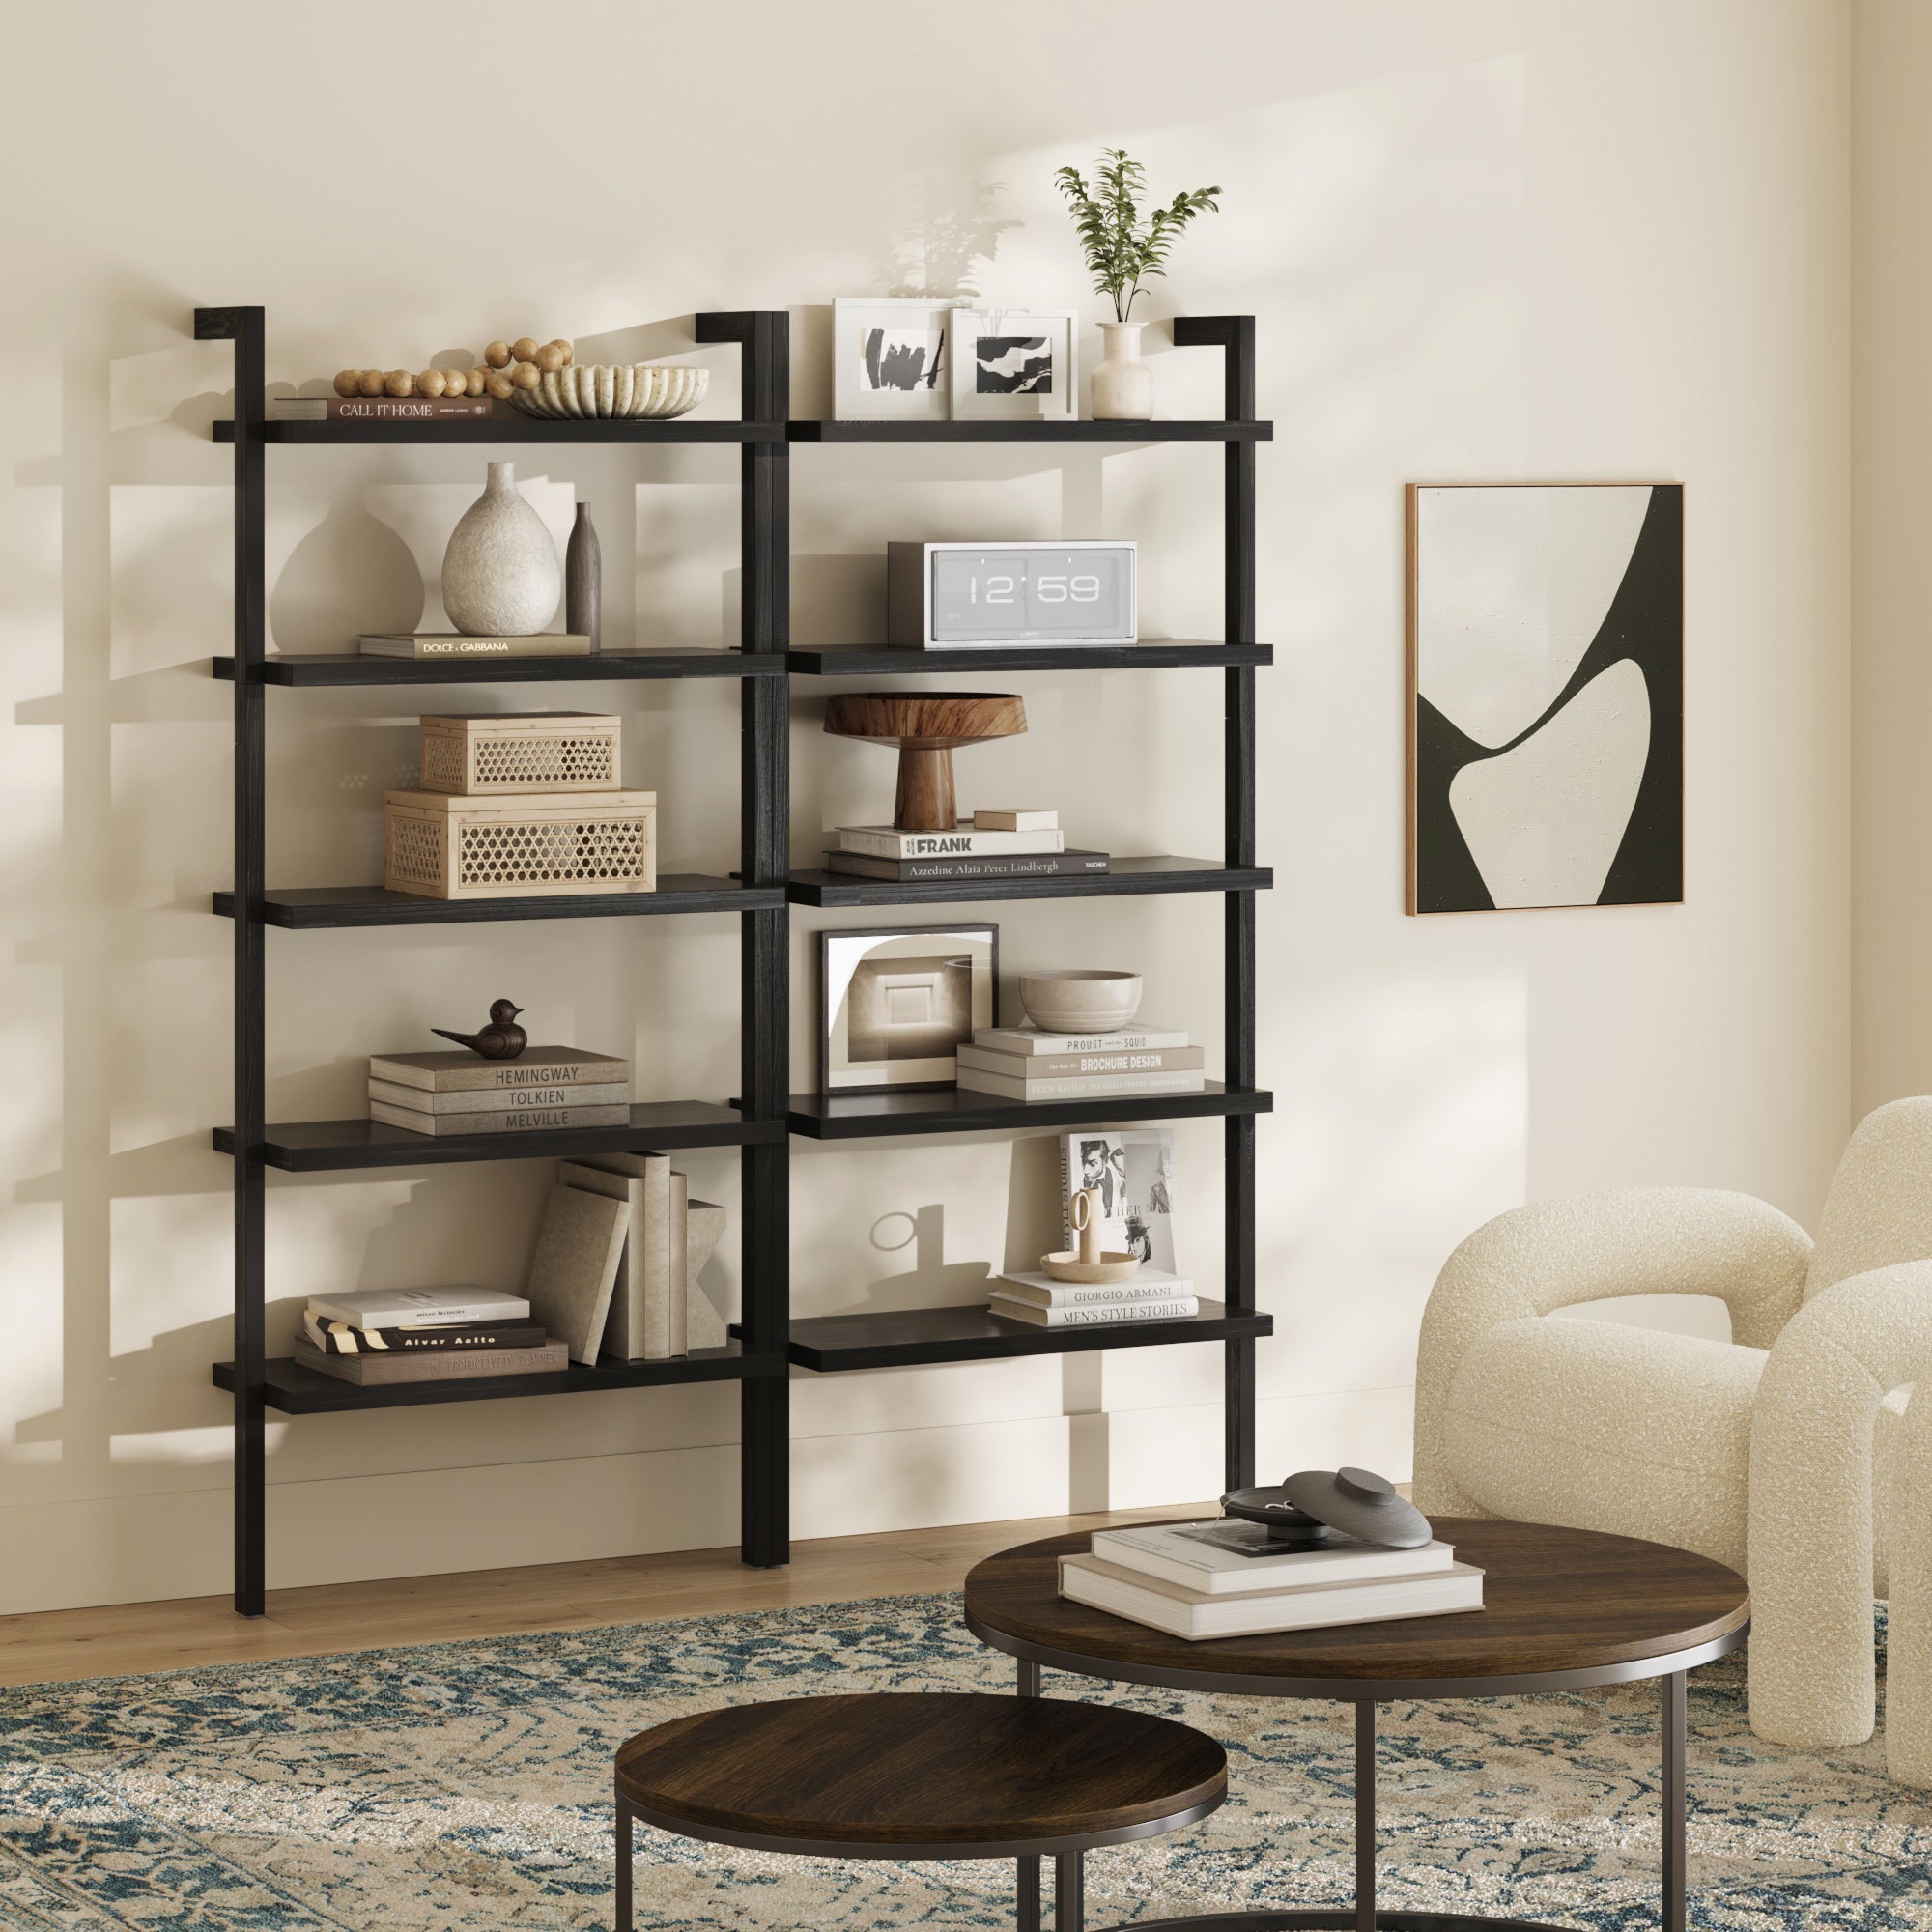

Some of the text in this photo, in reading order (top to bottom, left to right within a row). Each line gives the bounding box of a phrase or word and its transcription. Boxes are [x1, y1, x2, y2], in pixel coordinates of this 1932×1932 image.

[339, 404, 433, 416] CALL IT HOME
[423, 643, 454, 653] DOLCE
[460, 642, 509, 652] GABBANA
[917, 838, 972, 853] FRANK
[909, 866, 953, 876] Azzedine
[984, 864, 1008, 873] Peter
[1011, 861, 1059, 873] Lindbergh
[1067, 1039, 1102, 1050] PROUST
[1124, 1037, 1147, 1048] SQUID
[1081, 1054, 1162, 1071] BROCHURE DESIGN
[496, 1066, 579, 1084] HEMINGWAY
[508, 1090, 565, 1105] TOLKIEN
[506, 1112, 569, 1128] MELVILLE
[1074, 1287, 1172, 1302] GIORGIO ARMANI
[1064, 1303, 1187, 1323] MEN'S STYLE STORIES
